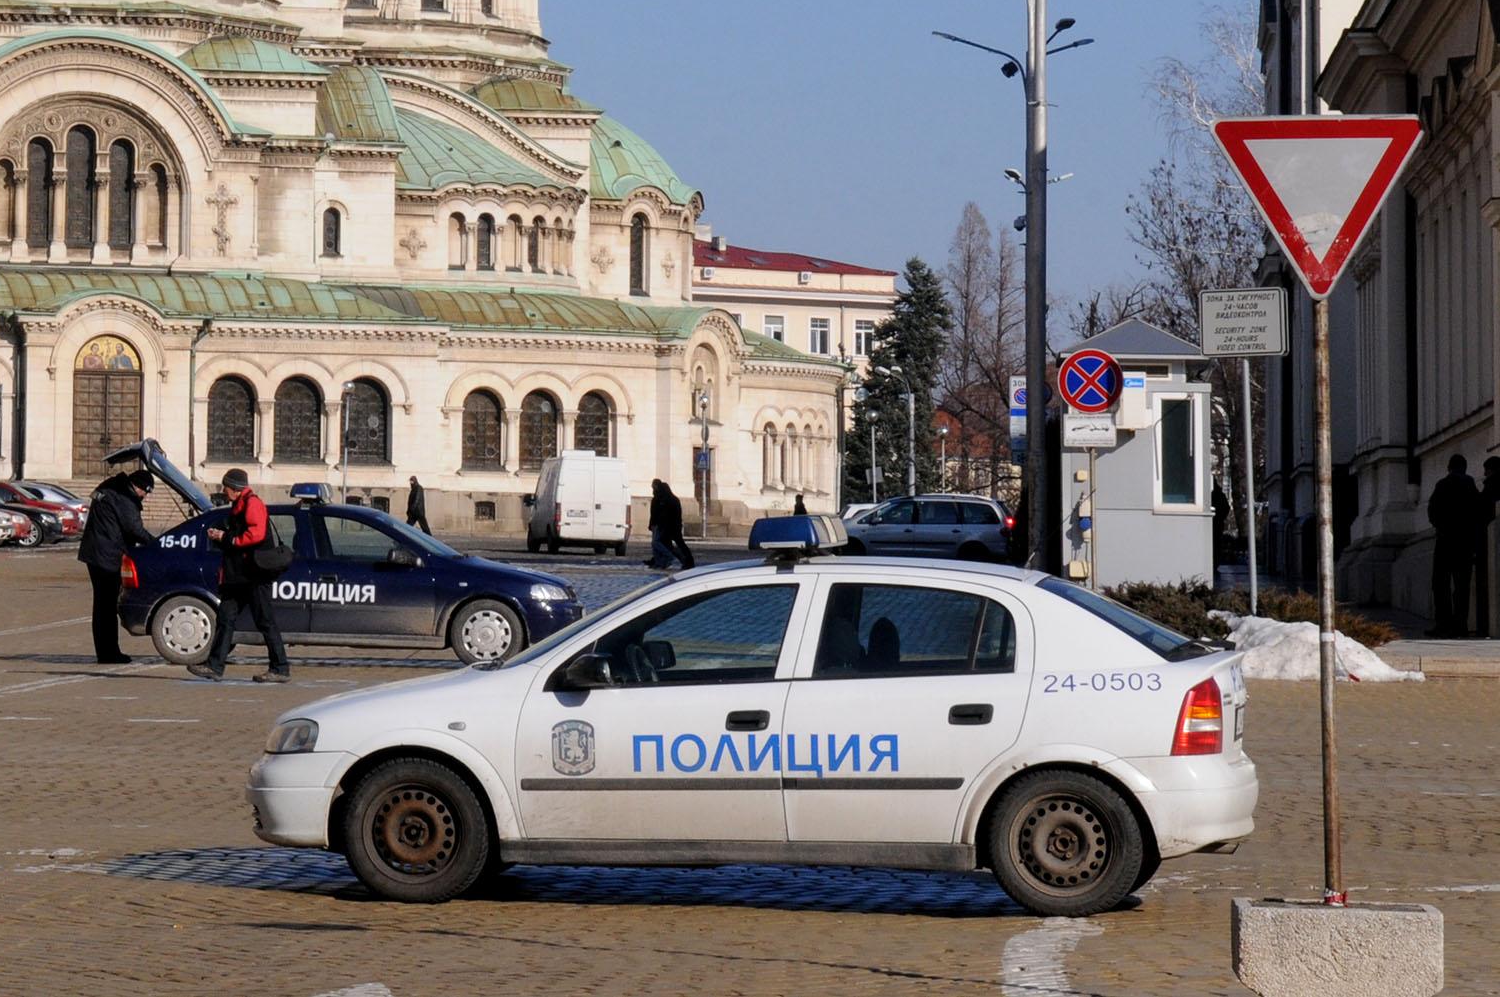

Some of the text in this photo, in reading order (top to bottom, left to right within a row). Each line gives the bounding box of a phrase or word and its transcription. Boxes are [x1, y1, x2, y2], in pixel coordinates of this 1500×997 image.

[1206, 294, 1223, 302] ЗОНА
[1237, 293, 1276, 301] СИГУРНОСТ
[1223, 303, 1258, 311] 24-ЧАСОВ
[1215, 310, 1267, 319] ВИДЕОКОНТРОЛ
[1214, 325, 1268, 334] SECURITY ZONE
[159, 534, 197, 548] 15-01
[1043, 672, 1162, 693] 24-0503
[632, 733, 899, 778] ПОЛИЦИЯ
